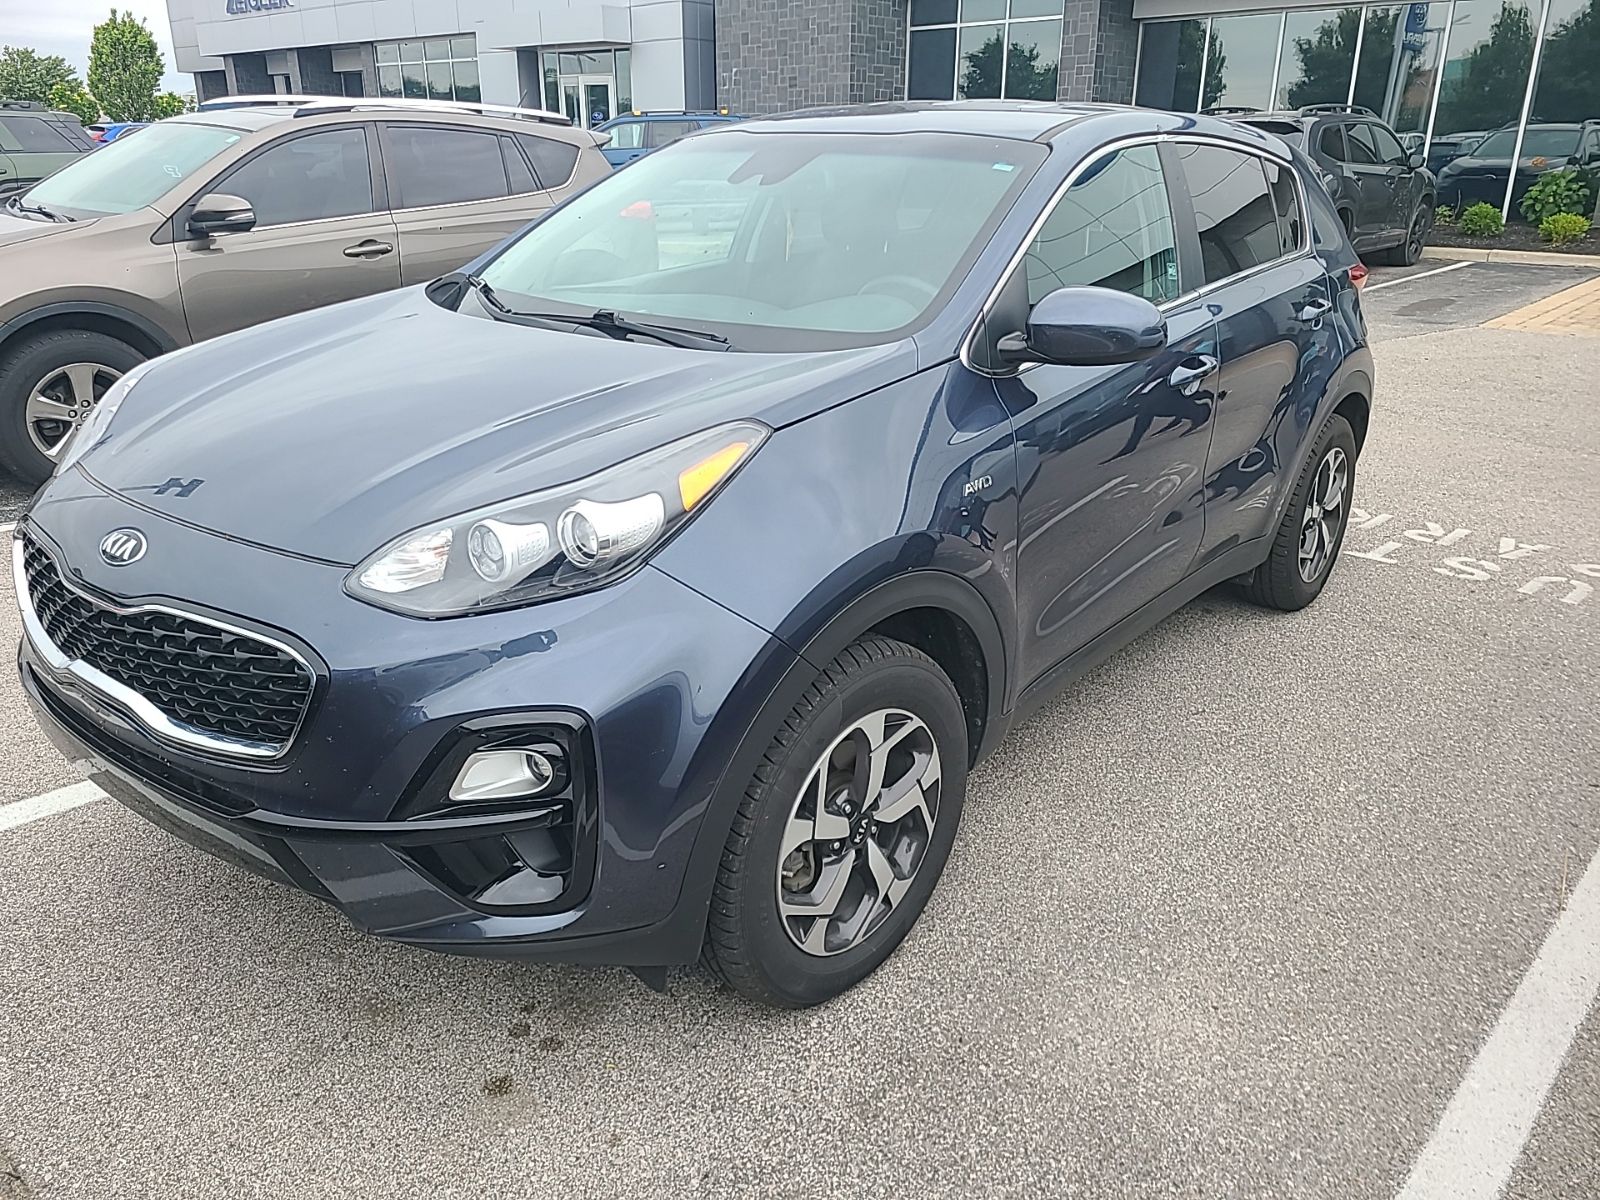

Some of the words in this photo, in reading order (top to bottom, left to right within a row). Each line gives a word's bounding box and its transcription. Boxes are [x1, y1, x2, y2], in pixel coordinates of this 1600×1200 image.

[226, 0, 294, 15] ZEIG
[963, 475, 993, 497] AWD
[102, 531, 138, 561] KIA
[853, 818, 869, 844] KIA
